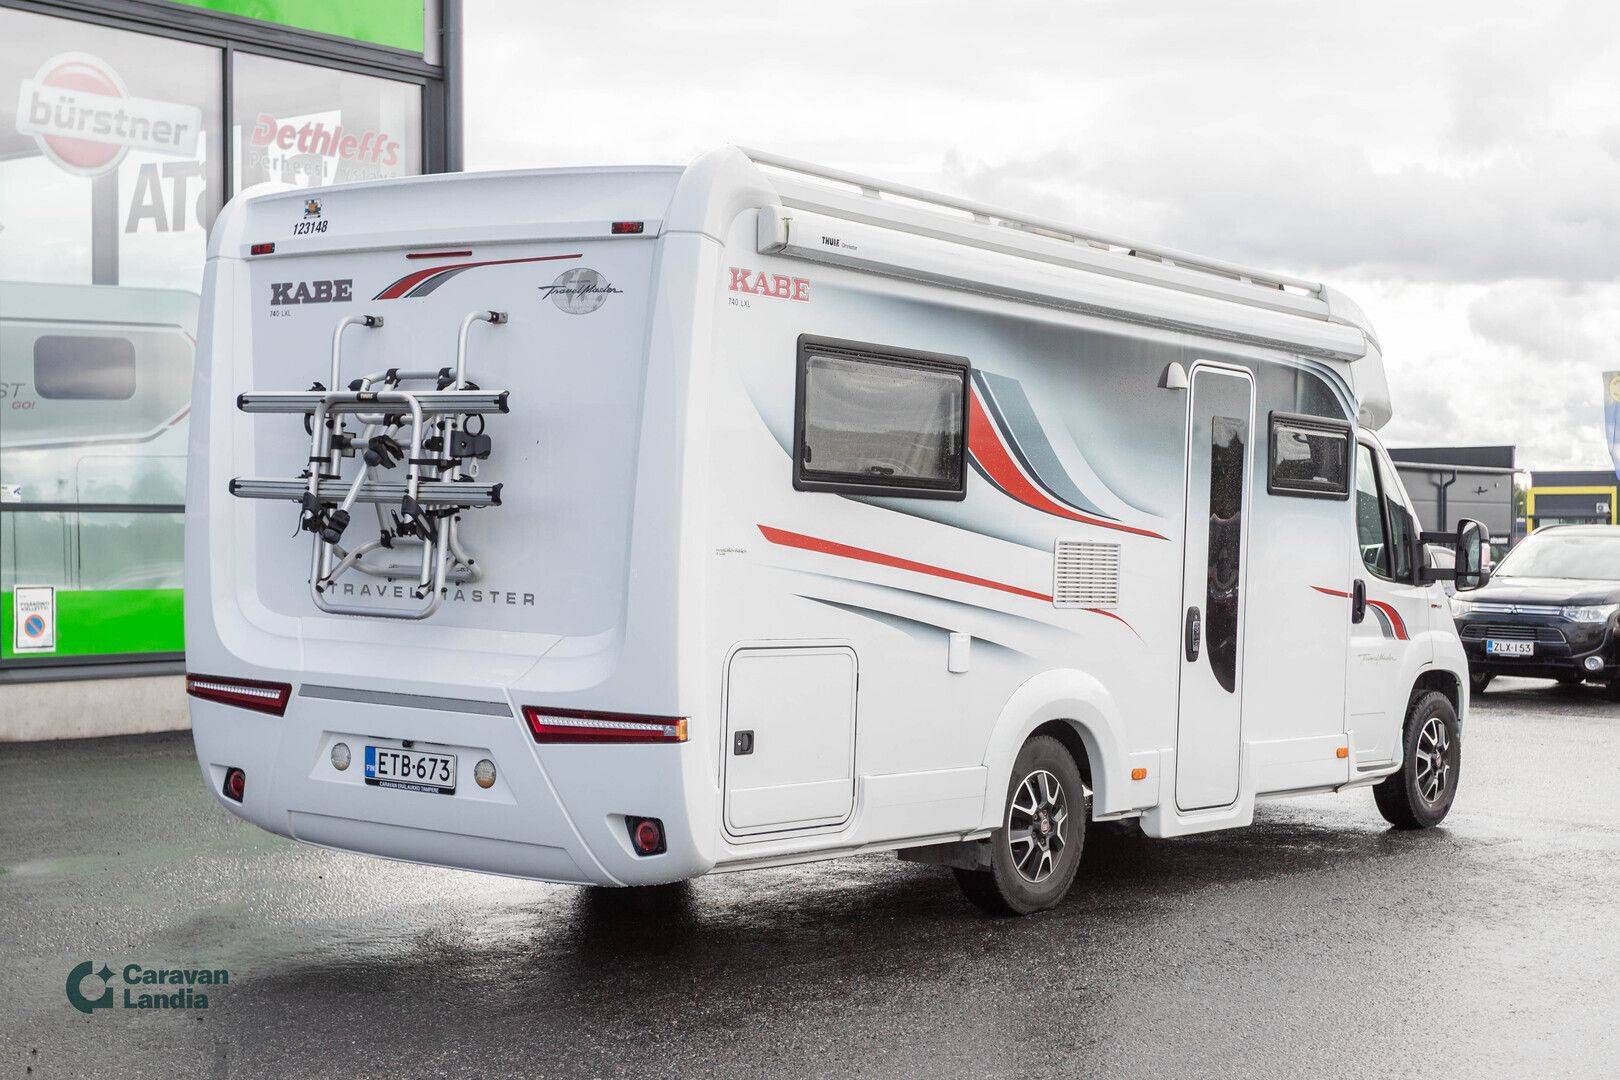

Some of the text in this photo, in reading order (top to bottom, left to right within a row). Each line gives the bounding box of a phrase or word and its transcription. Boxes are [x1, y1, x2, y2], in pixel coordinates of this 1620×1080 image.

[29, 91, 188, 145] bürstner
[251, 112, 400, 166] Dethleffs
[293, 220, 329, 235] 123148
[822, 236, 840, 247] THULE
[271, 279, 353, 306] KABE
[728, 267, 811, 302] KABE
[281, 309, 291, 317] LXL
[728, 297, 739, 306] 740
[378, 751, 451, 782] ETB-673
